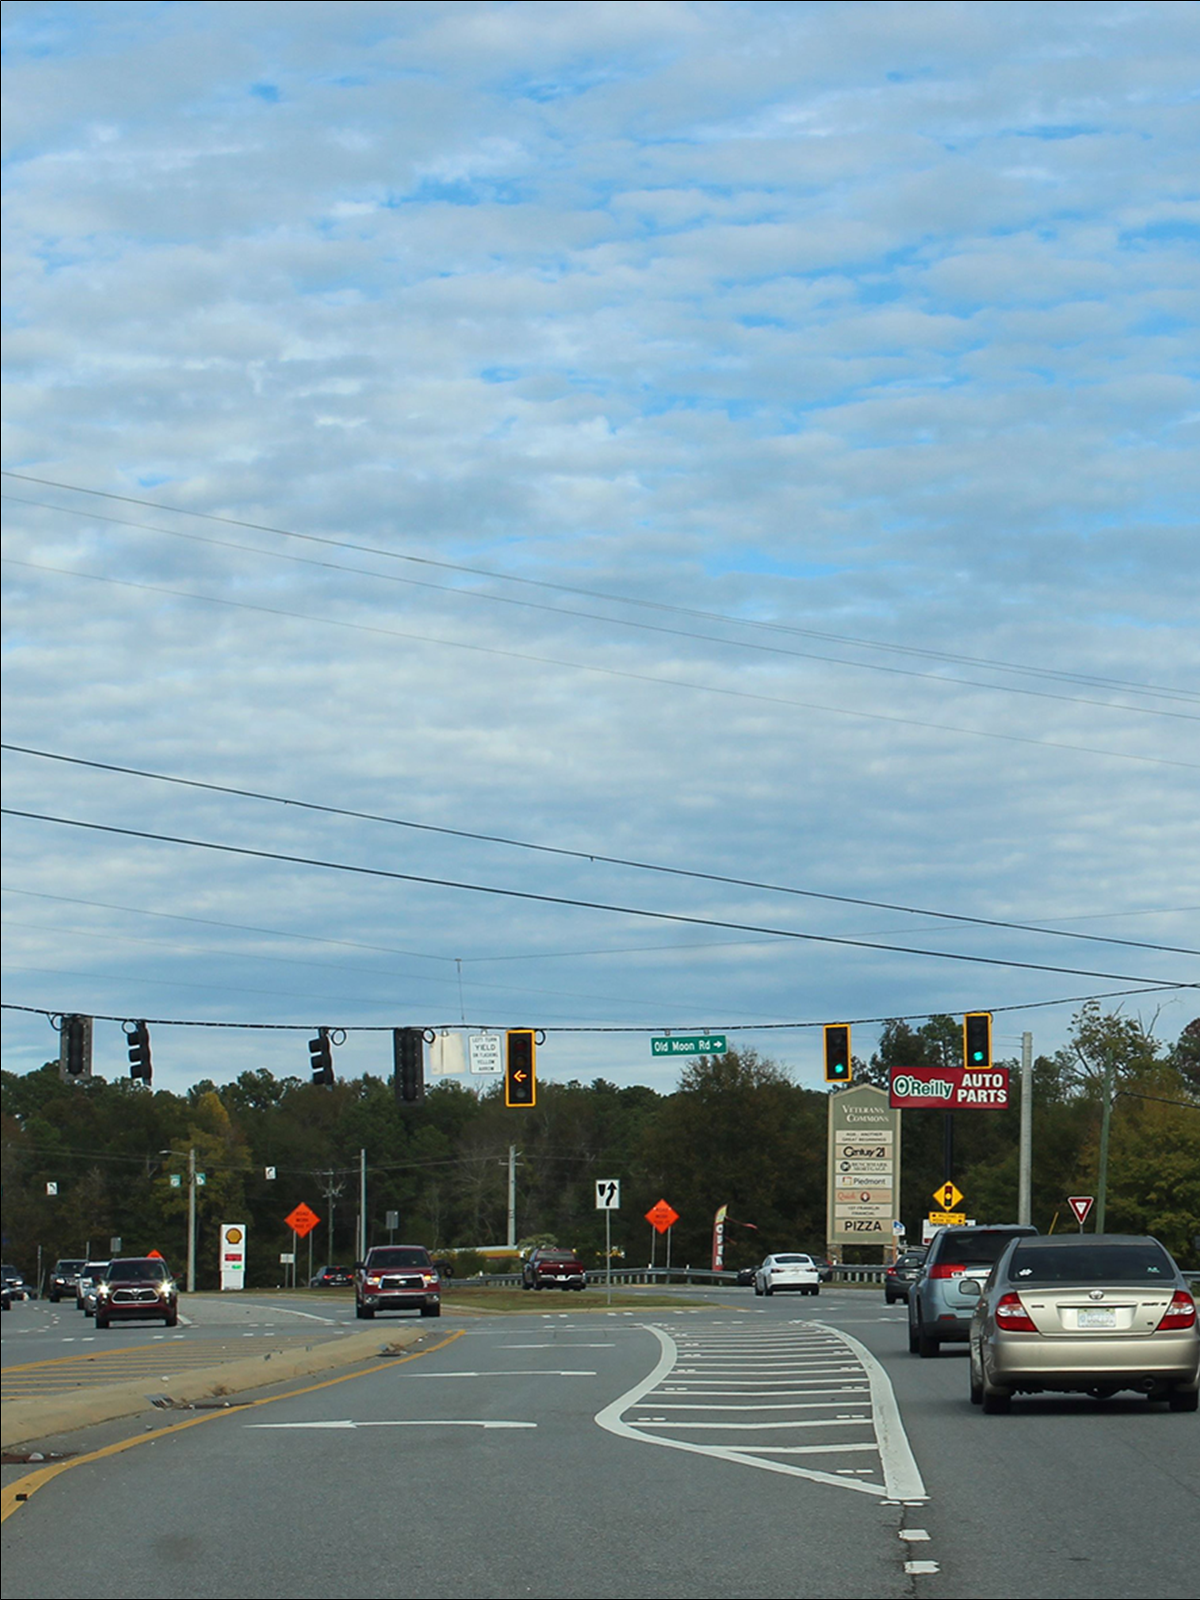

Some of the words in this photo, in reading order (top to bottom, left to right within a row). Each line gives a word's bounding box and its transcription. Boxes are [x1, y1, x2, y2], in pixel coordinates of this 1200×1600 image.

[654, 1041, 669, 1052] Old
[672, 1041, 695, 1051] Moon
[699, 1039, 711, 1050] Rd
[961, 1073, 1004, 1088] AUTO
[893, 1075, 954, 1099] O'Reilly
[957, 1089, 1007, 1103] PARTS
[842, 1104, 885, 1114] VETERANS
[846, 1113, 890, 1123] COMMONS
[853, 1177, 886, 1185] Piedmont
[844, 1220, 882, 1231] PIZZA
